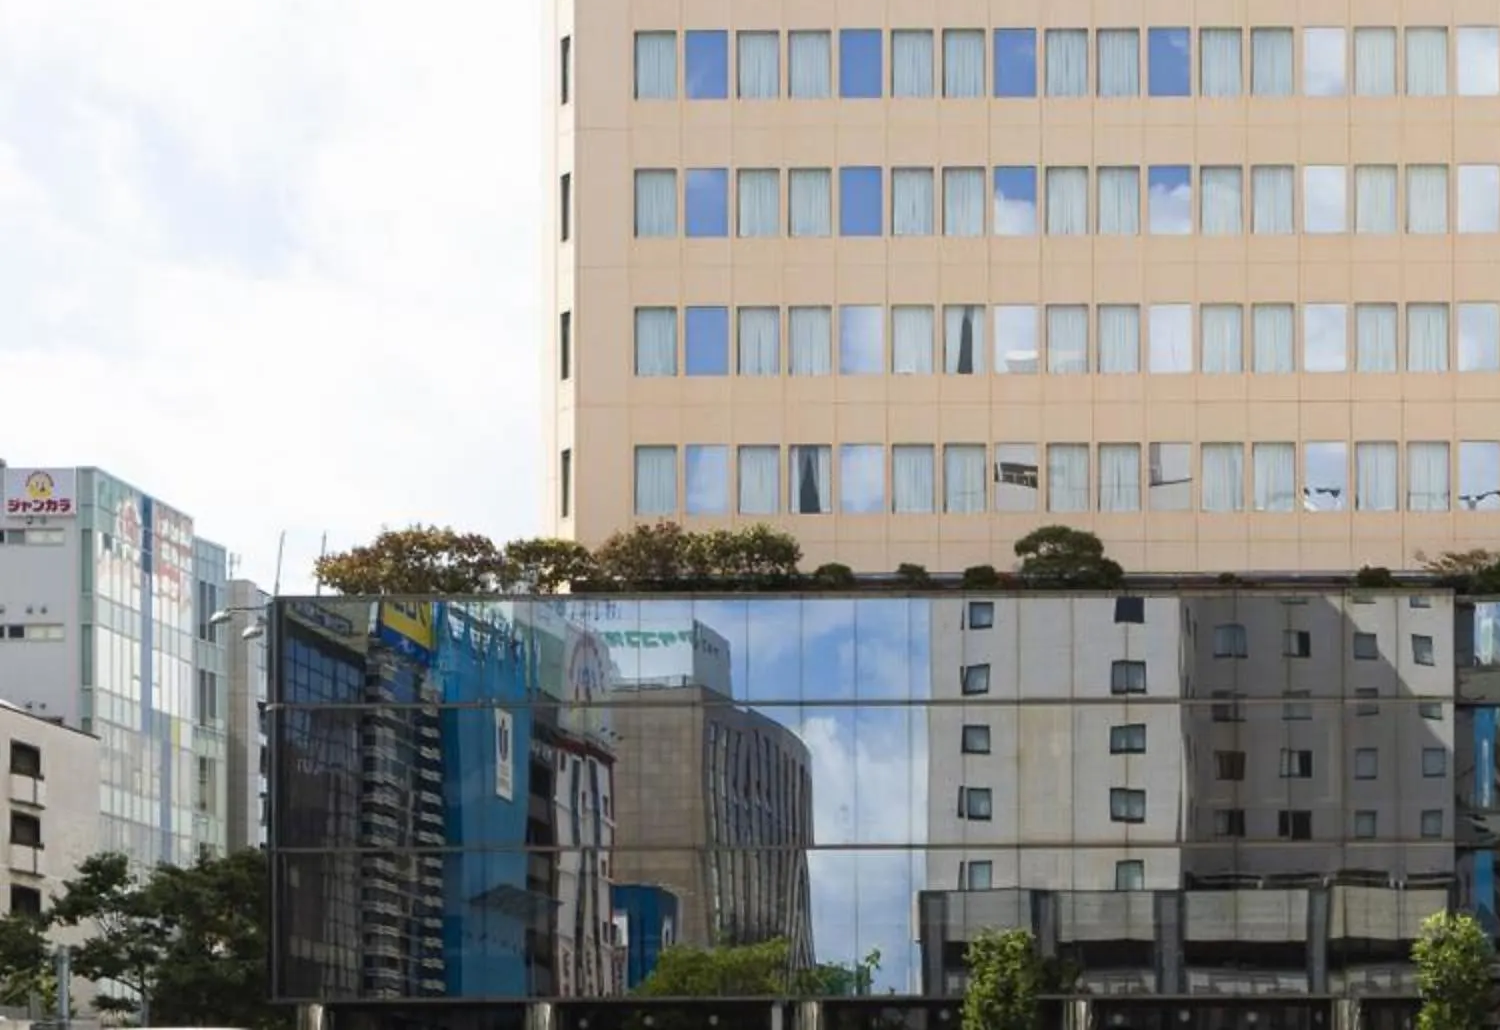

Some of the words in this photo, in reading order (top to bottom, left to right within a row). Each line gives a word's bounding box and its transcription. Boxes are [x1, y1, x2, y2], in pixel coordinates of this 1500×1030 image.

[7, 497, 71, 513] ジャンカラ
